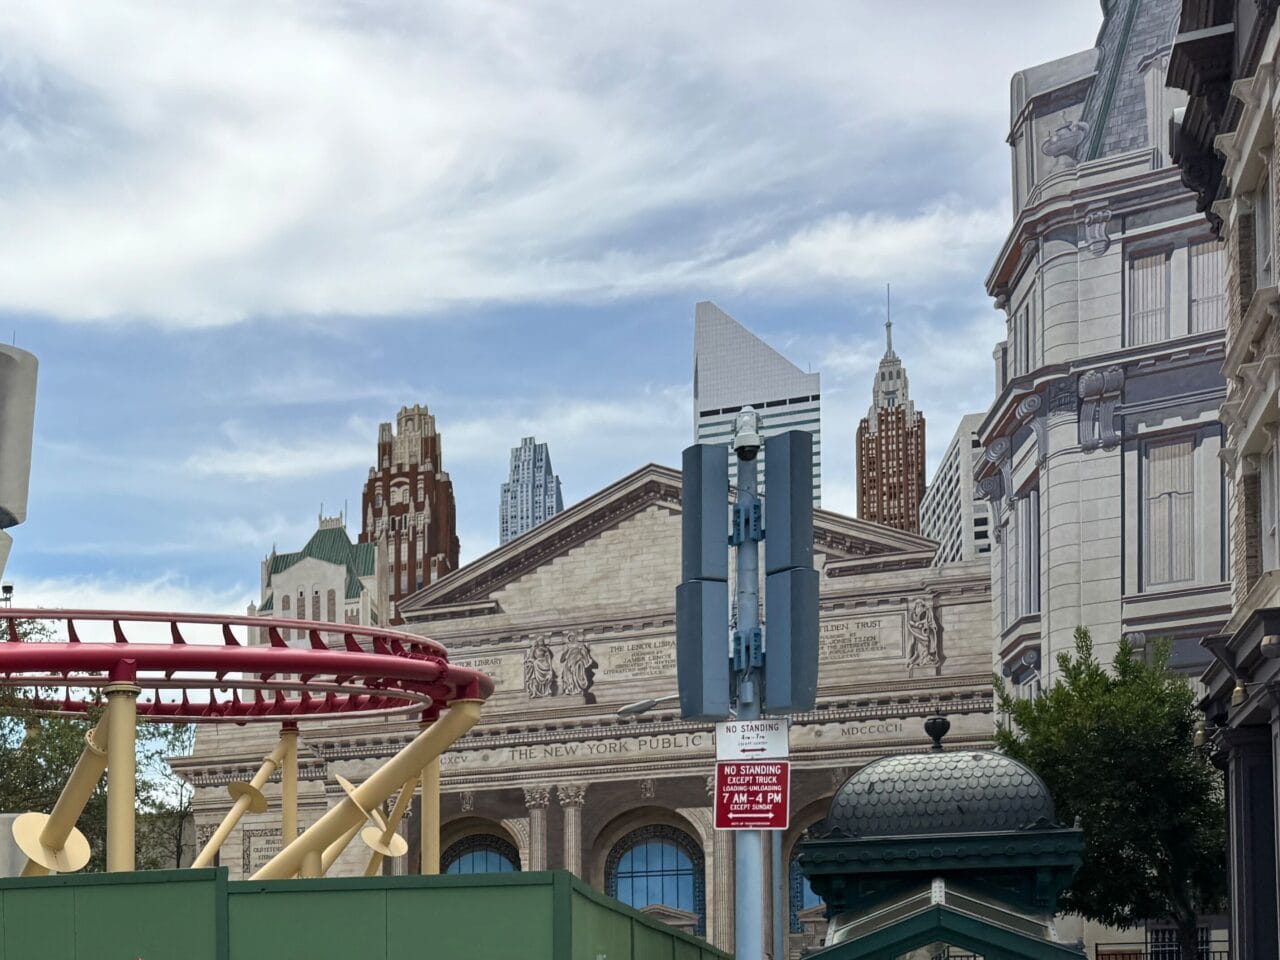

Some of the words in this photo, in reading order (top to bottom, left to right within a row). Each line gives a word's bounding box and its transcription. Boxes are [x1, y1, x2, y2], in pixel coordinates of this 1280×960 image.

[855, 620, 881, 629] TRUST
[610, 645, 625, 653] THE
[725, 725, 737, 734] NO
[740, 723, 780, 733] STANDING
[509, 748, 537, 761] THE
[543, 745, 580, 759] NEW
[587, 740, 629, 756] YORK
[638, 735, 702, 751] PUBLIC
[724, 766, 736, 775] NO
[740, 765, 781, 775] STANDING
[727, 776, 753, 784] EXCEPT
[755, 776, 777, 784] TRUCK
[722, 793, 730, 804] 7
[767, 793, 782, 803] PM
